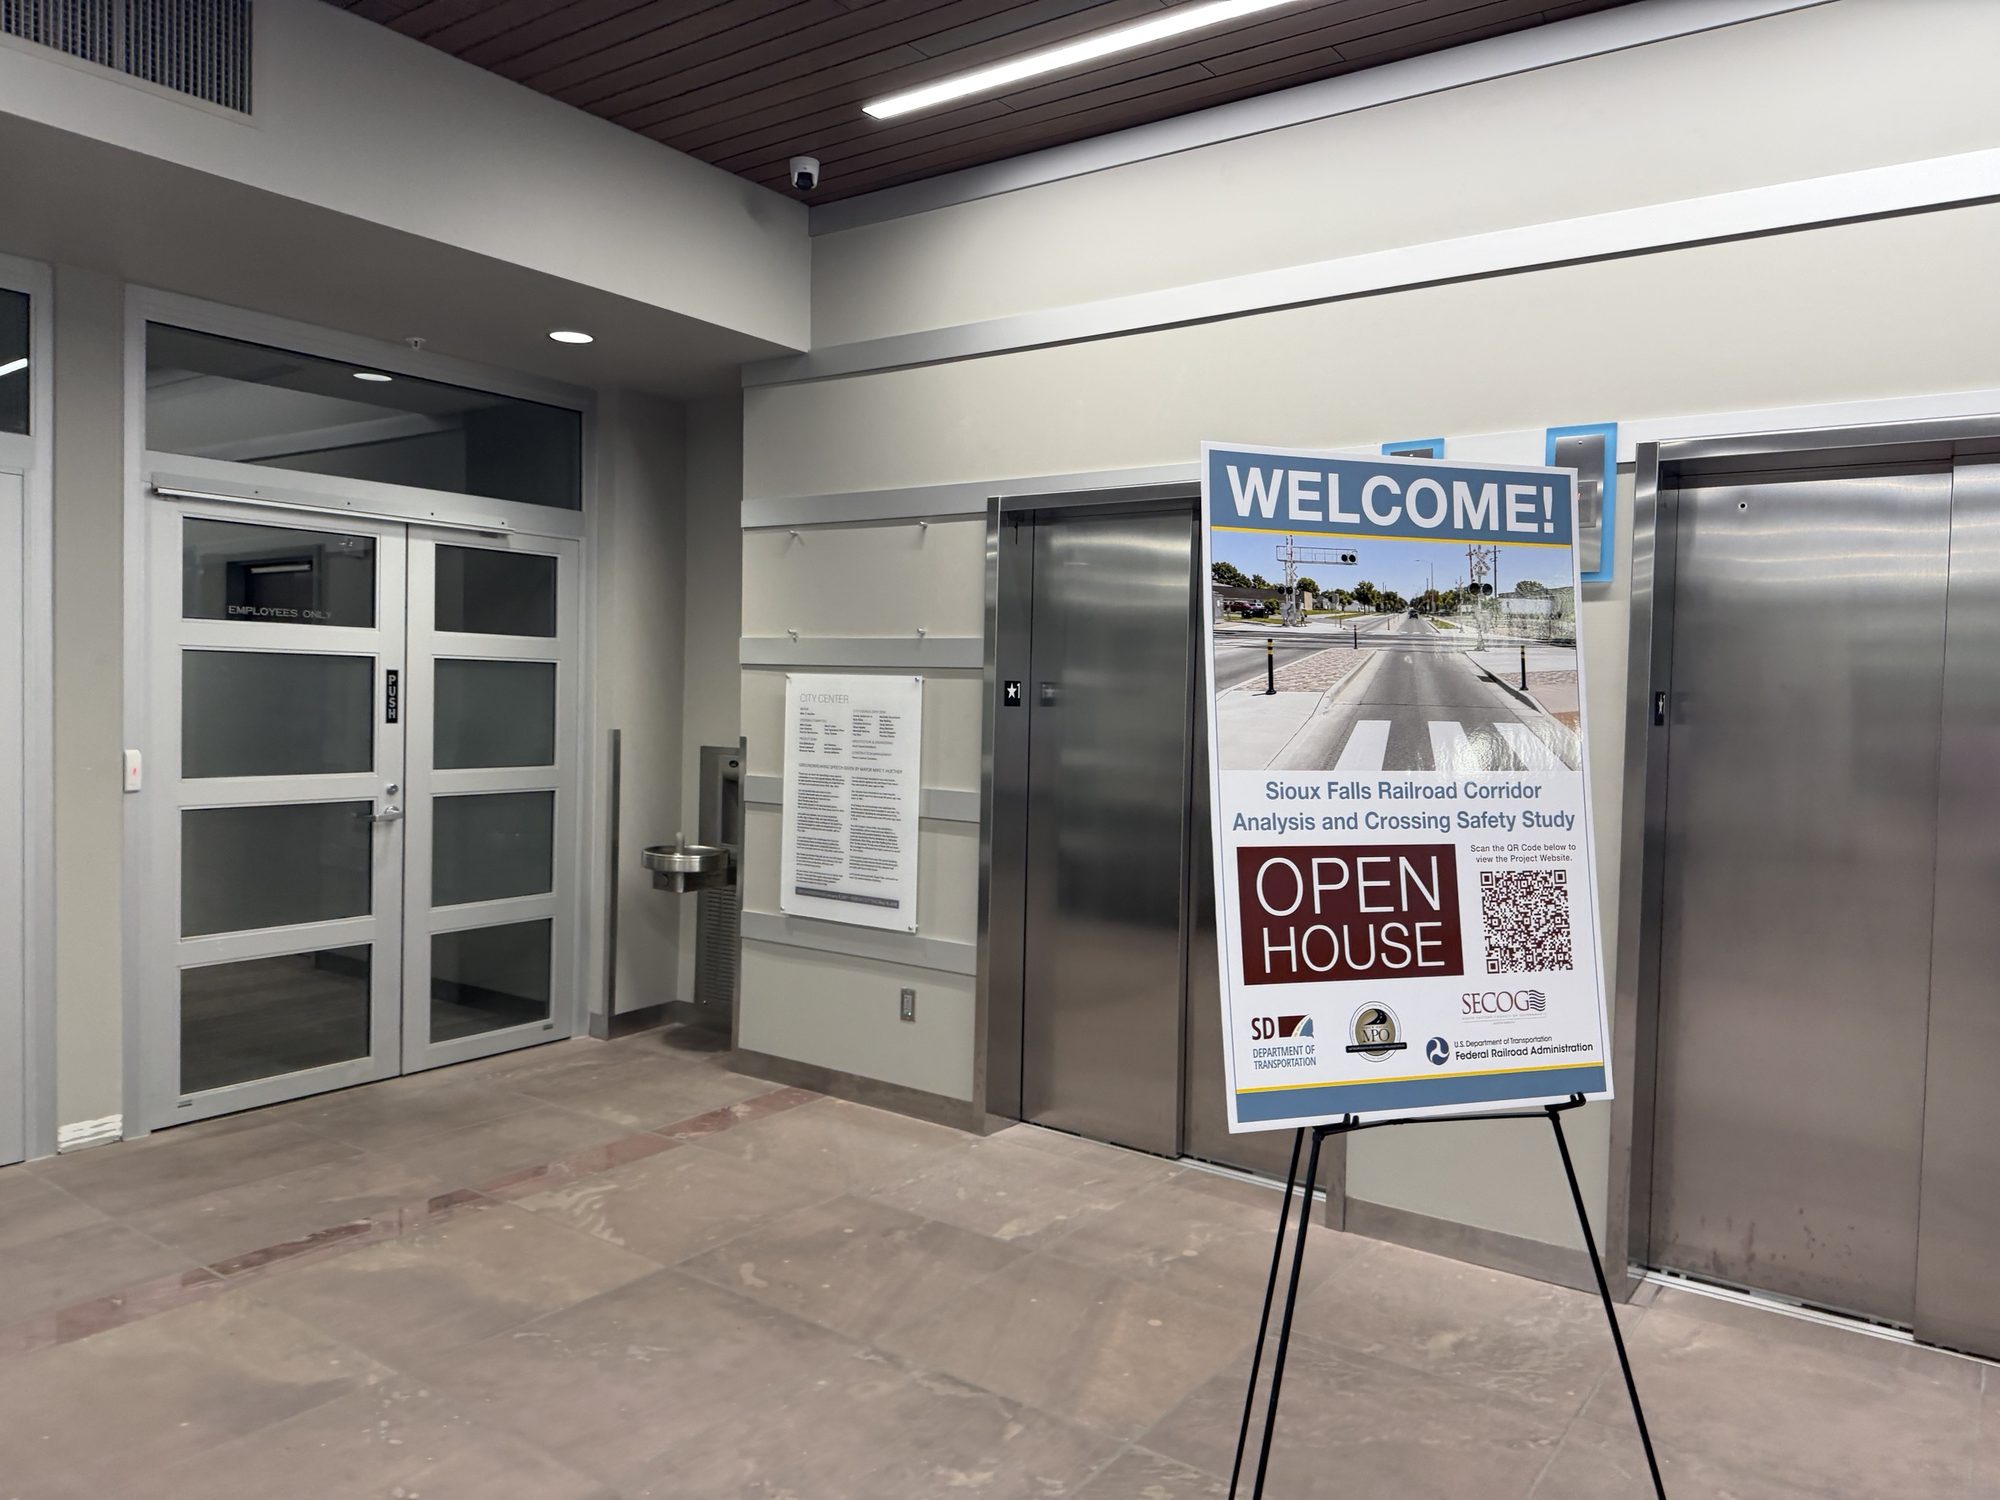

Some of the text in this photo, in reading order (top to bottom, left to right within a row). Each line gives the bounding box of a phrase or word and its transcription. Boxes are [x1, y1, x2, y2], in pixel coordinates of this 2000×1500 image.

[1226, 464, 1555, 534] WELCOME!
[228, 605, 332, 620] EMPLOYEES ONLY
[387, 674, 397, 719] PUSH
[799, 693, 849, 704] CITY CENTER
[1265, 781, 1542, 800] Sioux Falls Railroad Corridor
[1232, 810, 1576, 834] Analysis and Crossing Safety Study
[1470, 843, 1577, 852] Scan the QR Code below to
[1475, 854, 1573, 864] view the Project Website.
[1256, 855, 1441, 917] OPEN
[1262, 921, 1446, 974] HOUSE
[1461, 990, 1530, 1015] SECOG
[1251, 1016, 1275, 1041] SD
[1252, 1044, 1316, 1059] DEPARTMENT OF
[1454, 1040, 1465, 1049] U.S.
[1465, 1038, 1502, 1049] Department
[1509, 1035, 1553, 1046] Transportation
[1455, 1042, 1594, 1061] Federal Railroad Administration
[1254, 1056, 1317, 1070] TRANSPORTATION
